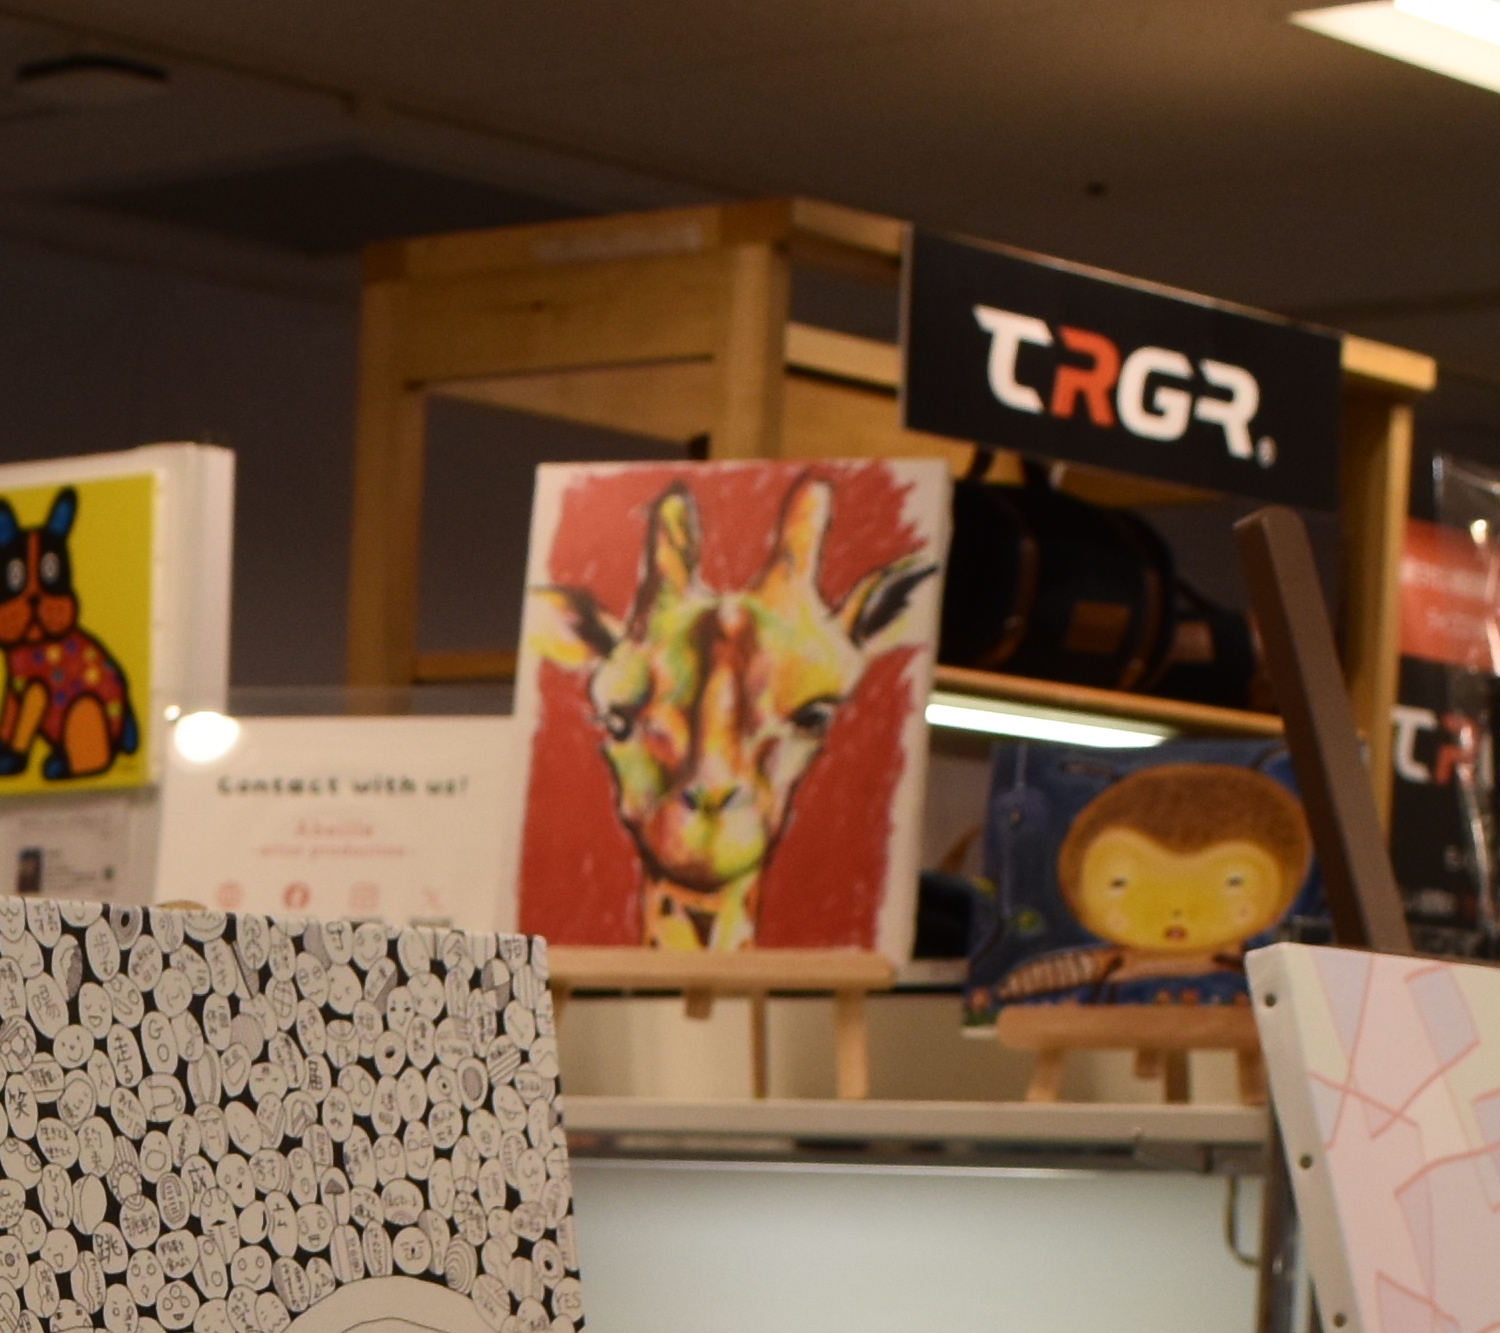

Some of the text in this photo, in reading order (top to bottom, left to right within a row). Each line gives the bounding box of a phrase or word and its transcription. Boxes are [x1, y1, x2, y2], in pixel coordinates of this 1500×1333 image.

[972, 304, 1263, 462] TRGR
[216, 774, 340, 796] Contact
[352, 774, 417, 794] with
